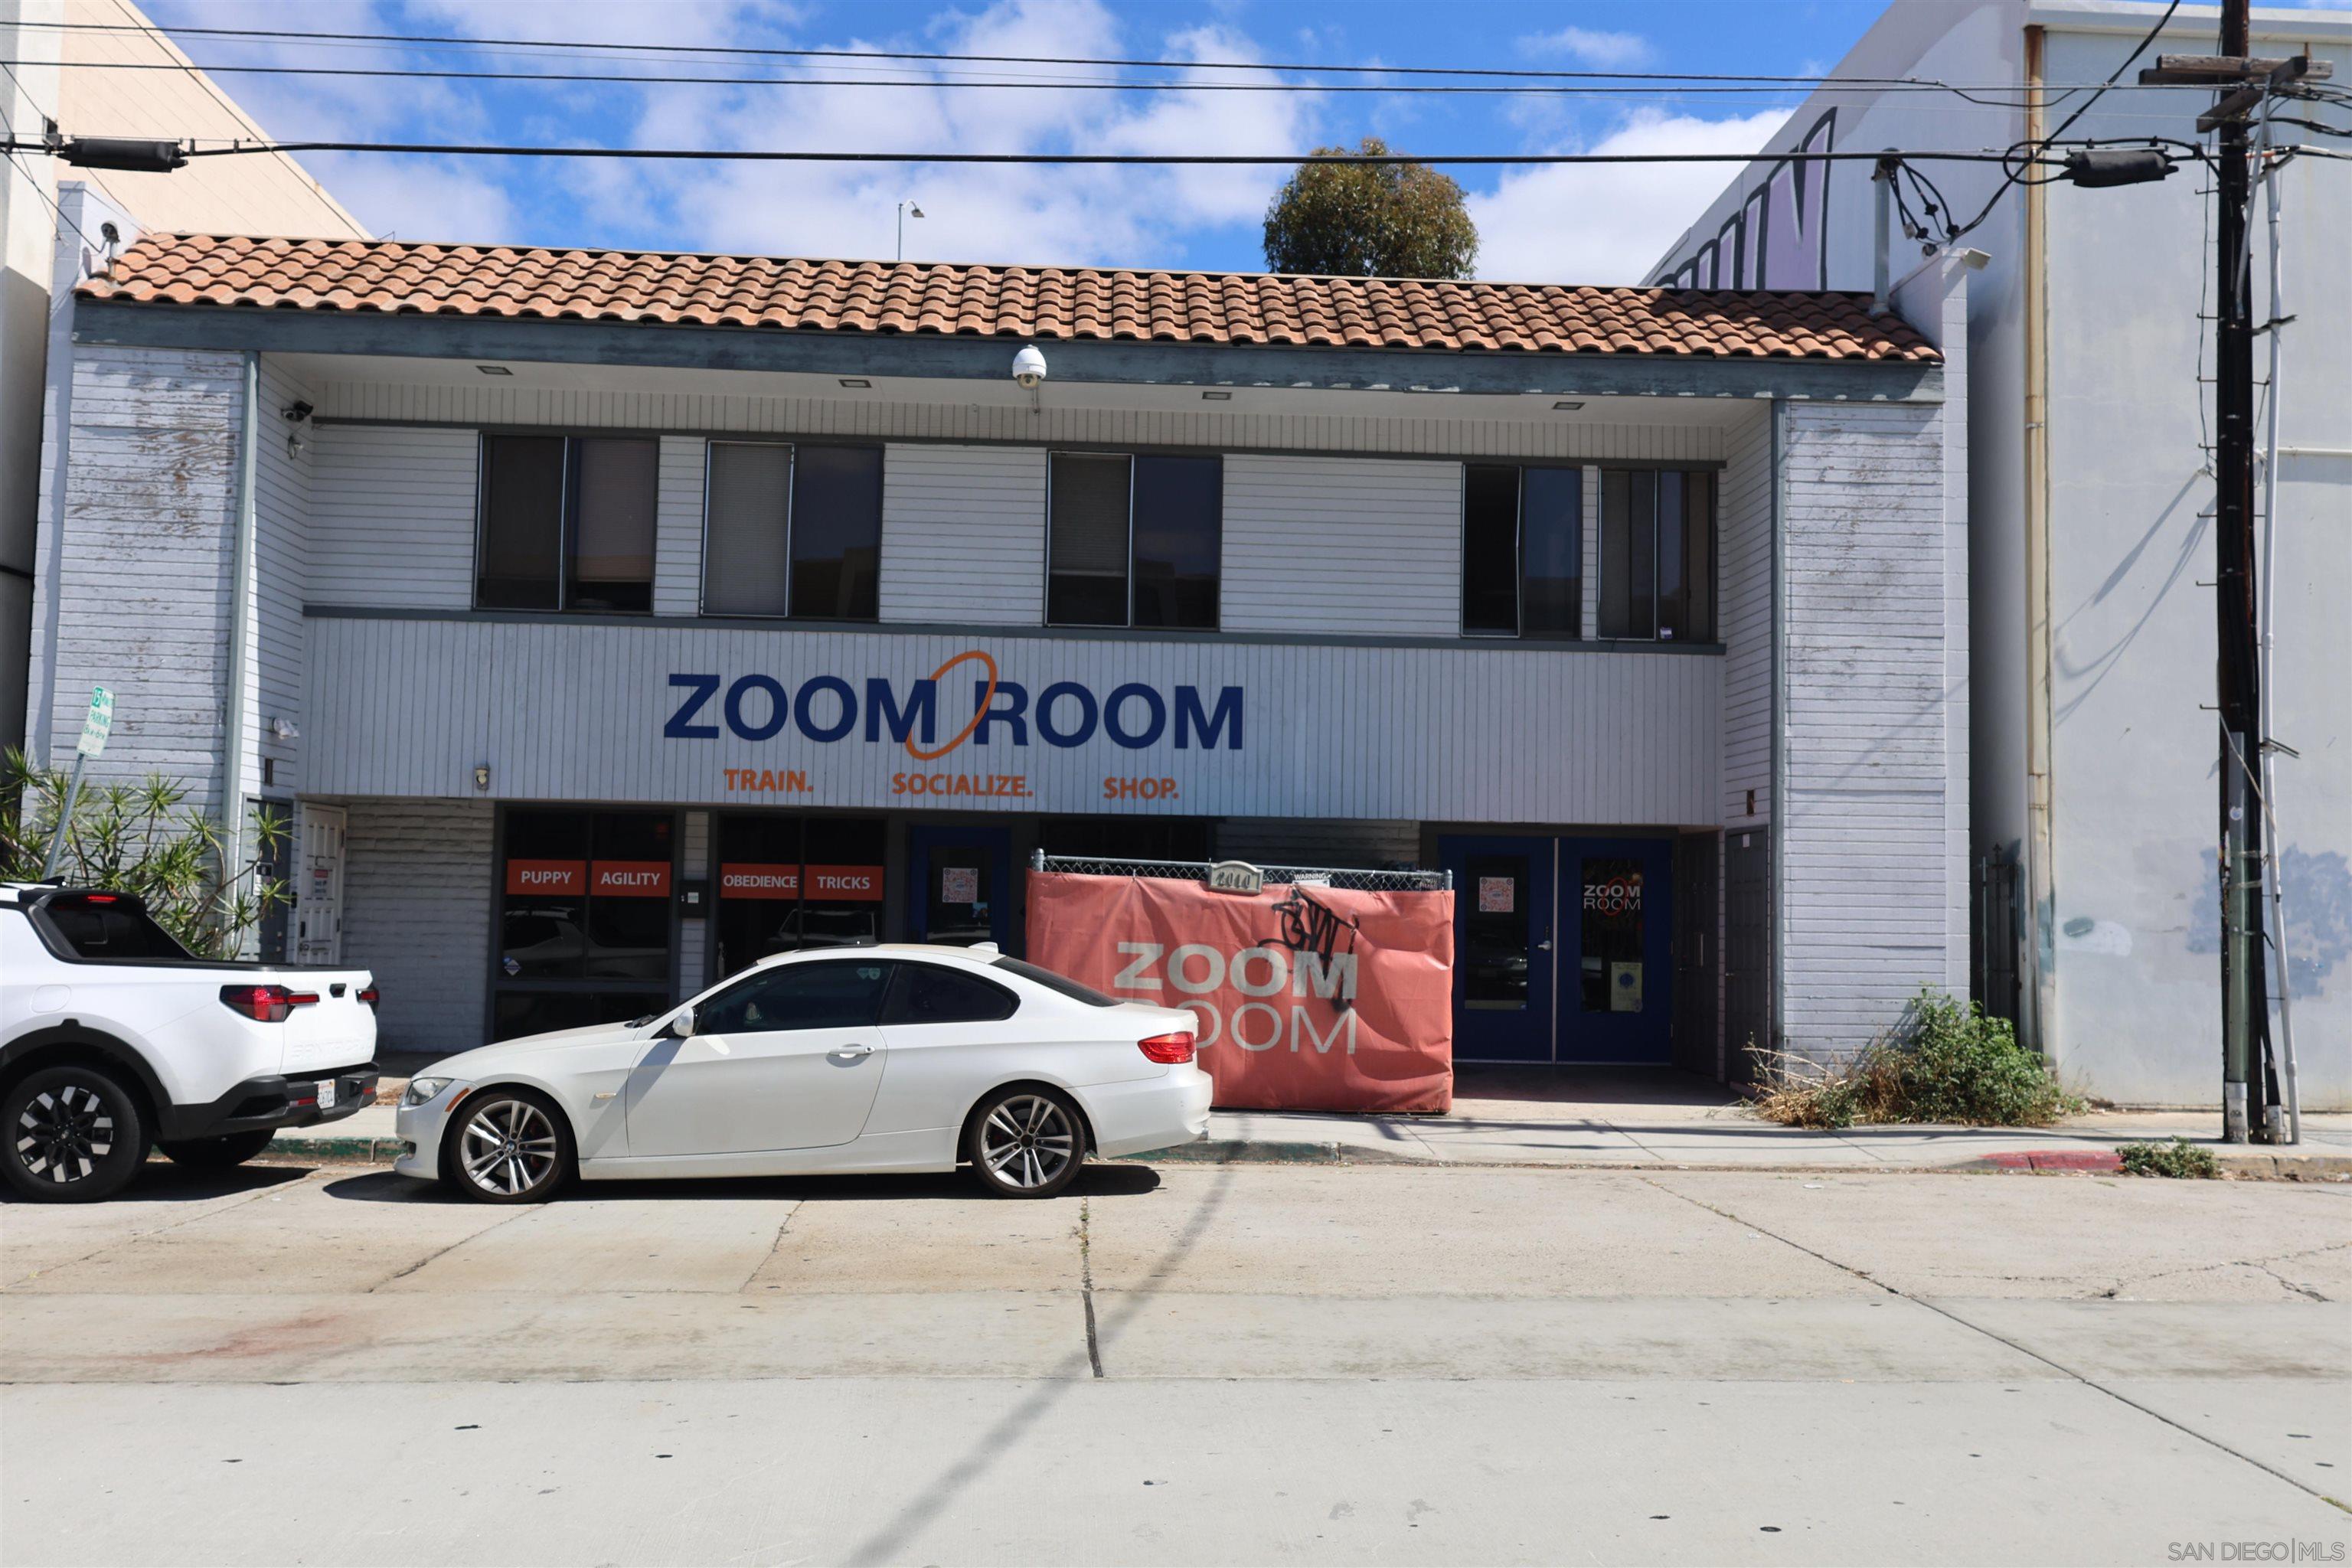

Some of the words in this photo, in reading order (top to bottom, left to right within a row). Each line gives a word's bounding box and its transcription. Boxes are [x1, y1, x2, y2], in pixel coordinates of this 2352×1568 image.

[90, 709, 111, 727] PARKING
[664, 673, 937, 743] ZOOM
[973, 680, 1244, 750] ROOM
[724, 769, 814, 792] TRAIN.
[892, 773, 1034, 797] SOCIALIZE.
[1103, 776, 1180, 799] SHOP.
[521, 871, 572, 884] PUPPY
[600, 871, 661, 886] AGILITY
[723, 874, 798, 888] OBEDIENCE
[817, 876, 871, 890] TRICKS
[1583, 884, 1641, 897] ZOOM
[1583, 897, 1641, 910] ROOM
[1113, 941, 1359, 999] ZOOM
[1113, 997, 1357, 1054] OOM
